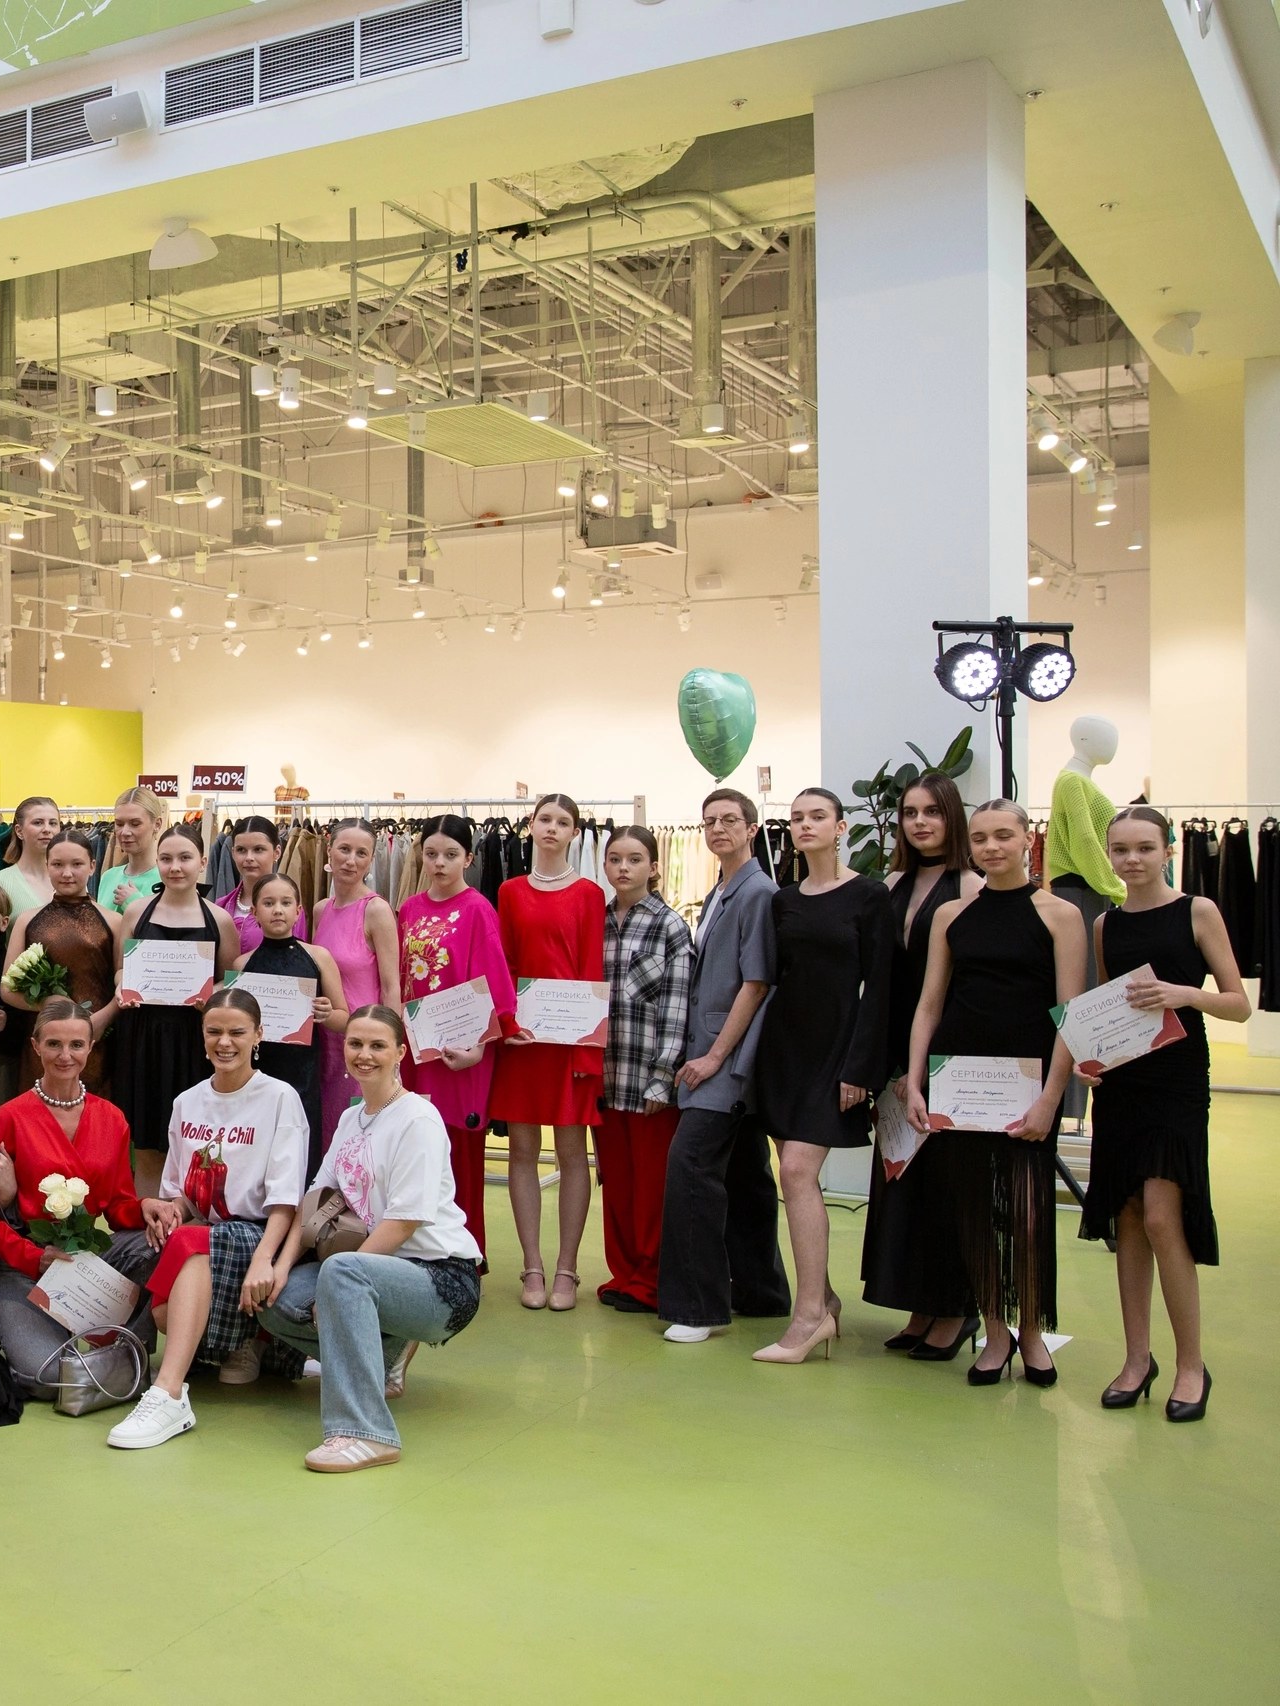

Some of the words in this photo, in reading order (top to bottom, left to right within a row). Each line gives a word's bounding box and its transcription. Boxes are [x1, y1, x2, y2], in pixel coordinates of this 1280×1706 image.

[154, 780, 179, 793] 50%
[193, 775, 211, 787] до
[214, 772, 245, 786] 50%
[141, 951, 197, 960] СЕРТИФИКАТ
[534, 990, 592, 1000] СЕРТИФИКАТ
[425, 992, 475, 1016] СЕРТИФИКАТ
[950, 1069, 1020, 1080] СЕРТИФИКАТ
[180, 1121, 213, 1142] Mollis
[227, 1126, 255, 1146] Chill
[76, 1261, 129, 1303] СЕРТИФИКАТ
